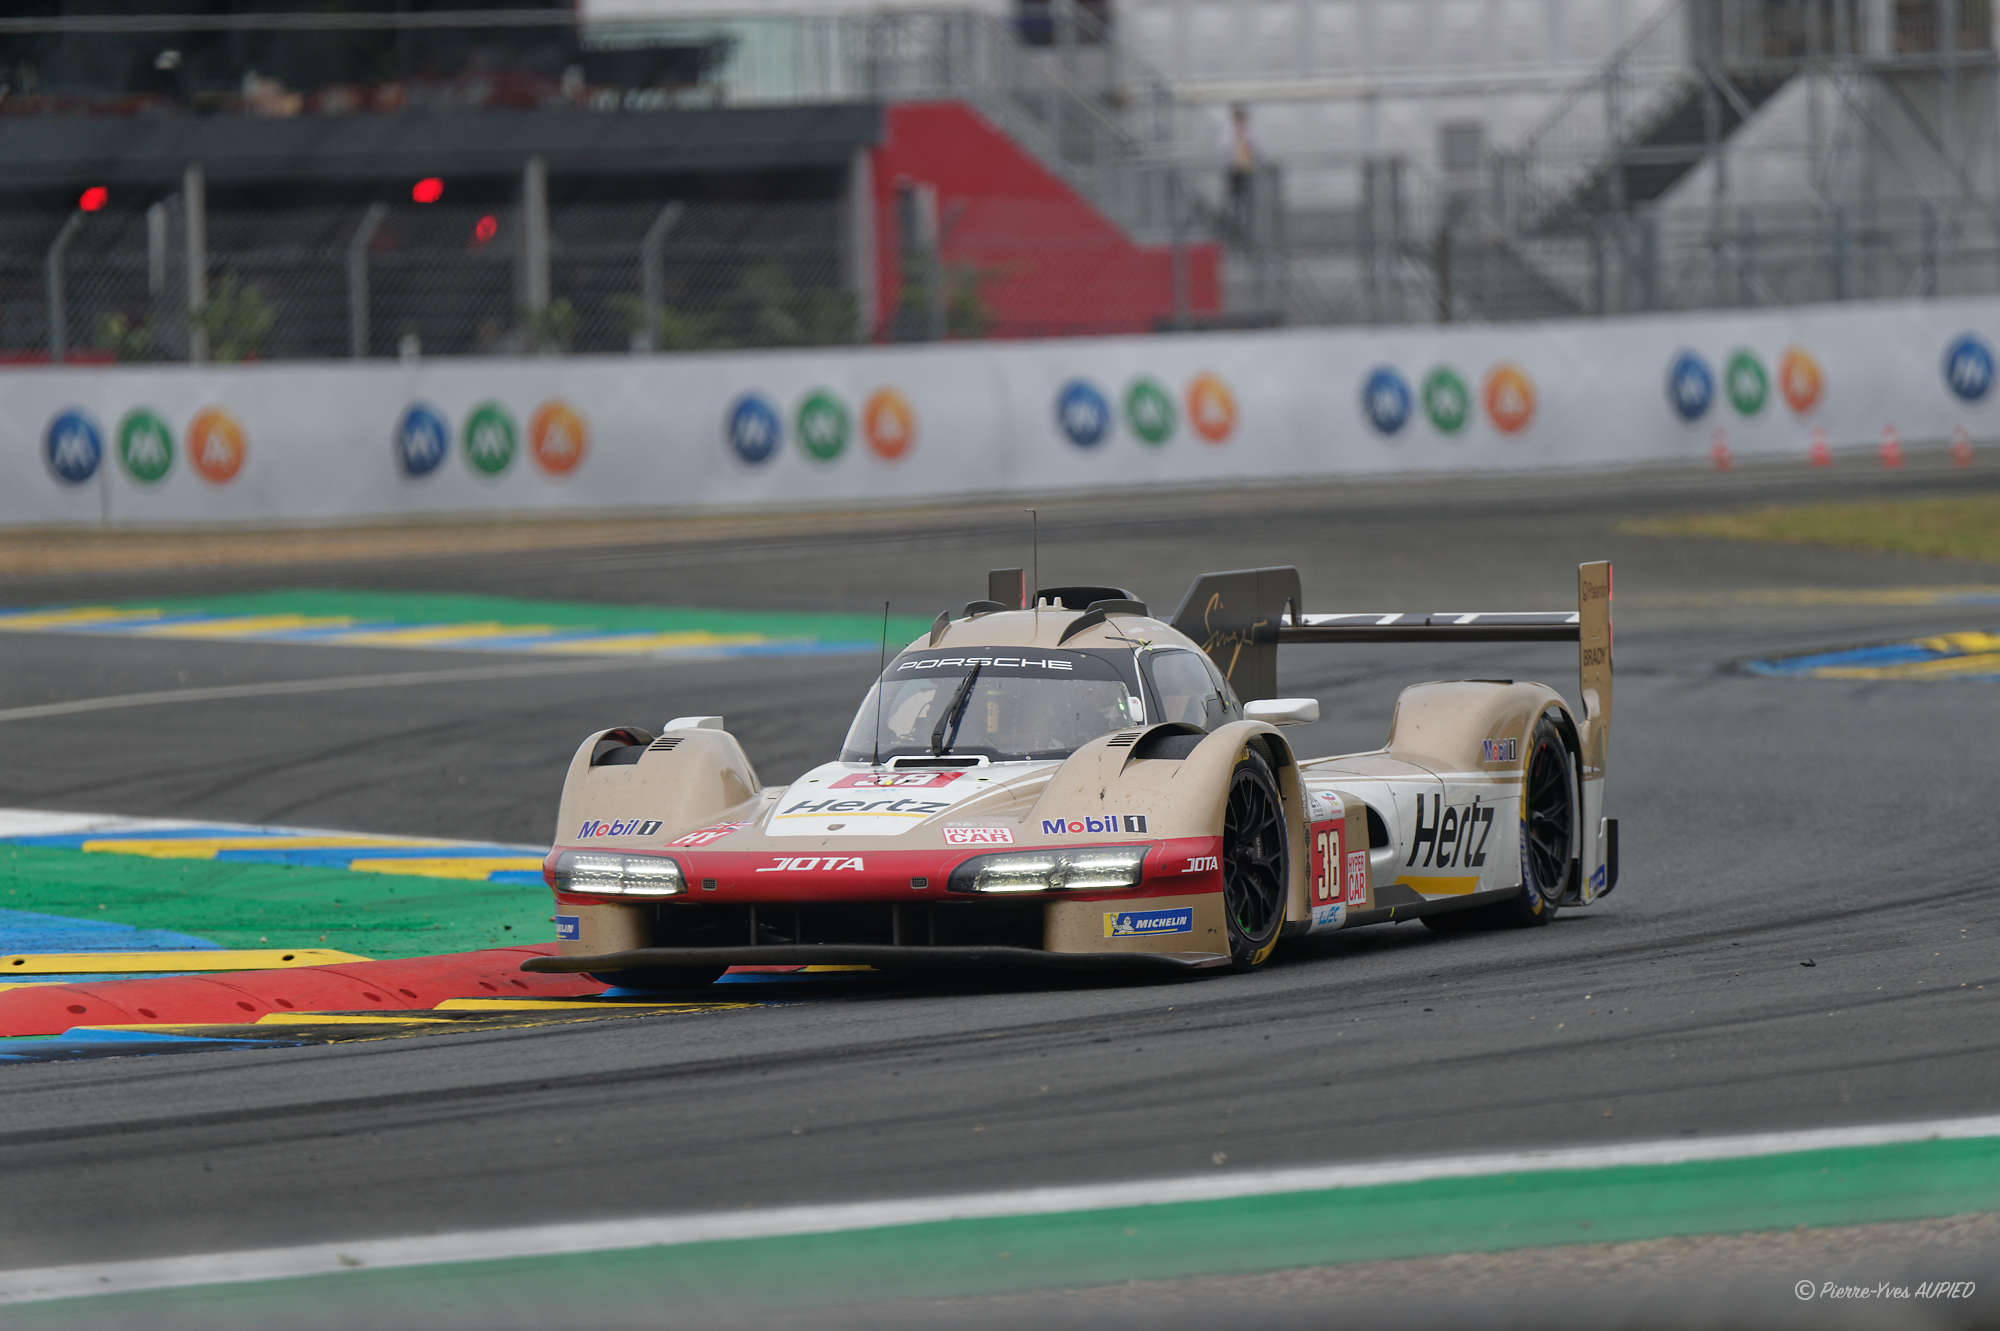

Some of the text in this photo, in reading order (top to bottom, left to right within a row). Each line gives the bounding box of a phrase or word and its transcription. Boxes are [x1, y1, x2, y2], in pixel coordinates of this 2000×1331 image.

[897, 657, 1073, 672] PORSCHE
[782, 799, 950, 814] Hertz
[577, 819, 639, 839] Mobil
[1042, 815, 1118, 835] Mobil
[1406, 793, 1494, 868] Hertz
[949, 833, 1009, 843] CAR
[756, 857, 865, 872] JOTA
[1181, 856, 1218, 873] JOTA
[1317, 829, 1340, 900] 38
[1348, 873, 1366, 901] CAR
[1135, 916, 1188, 929] MICHELIN
